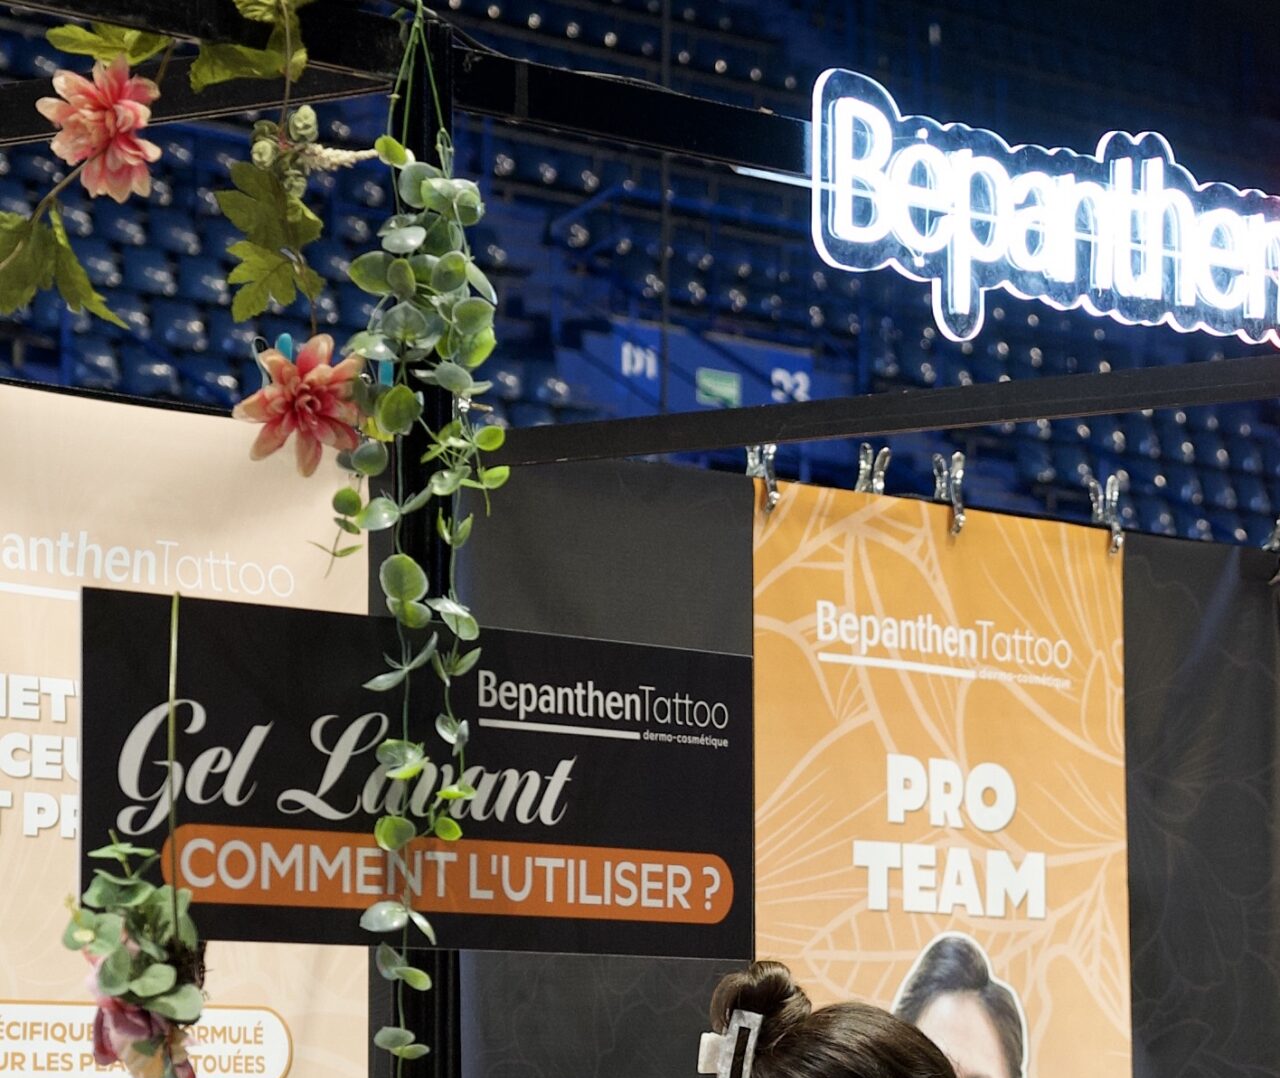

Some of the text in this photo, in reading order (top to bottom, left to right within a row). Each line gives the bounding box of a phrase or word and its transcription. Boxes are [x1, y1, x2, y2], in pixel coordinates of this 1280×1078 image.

[116, 698, 275, 836] Gel
[643, 729, 729, 748] dermo-cosmétique
[886, 752, 1017, 832] PRO
[180, 837, 458, 898] COMMENT
[469, 854, 692, 909] L'UTILISER
[853, 840, 1046, 919] TEAM
[32, 1051, 74, 1072] LES
[193, 1050, 266, 1074] TOUÉES
